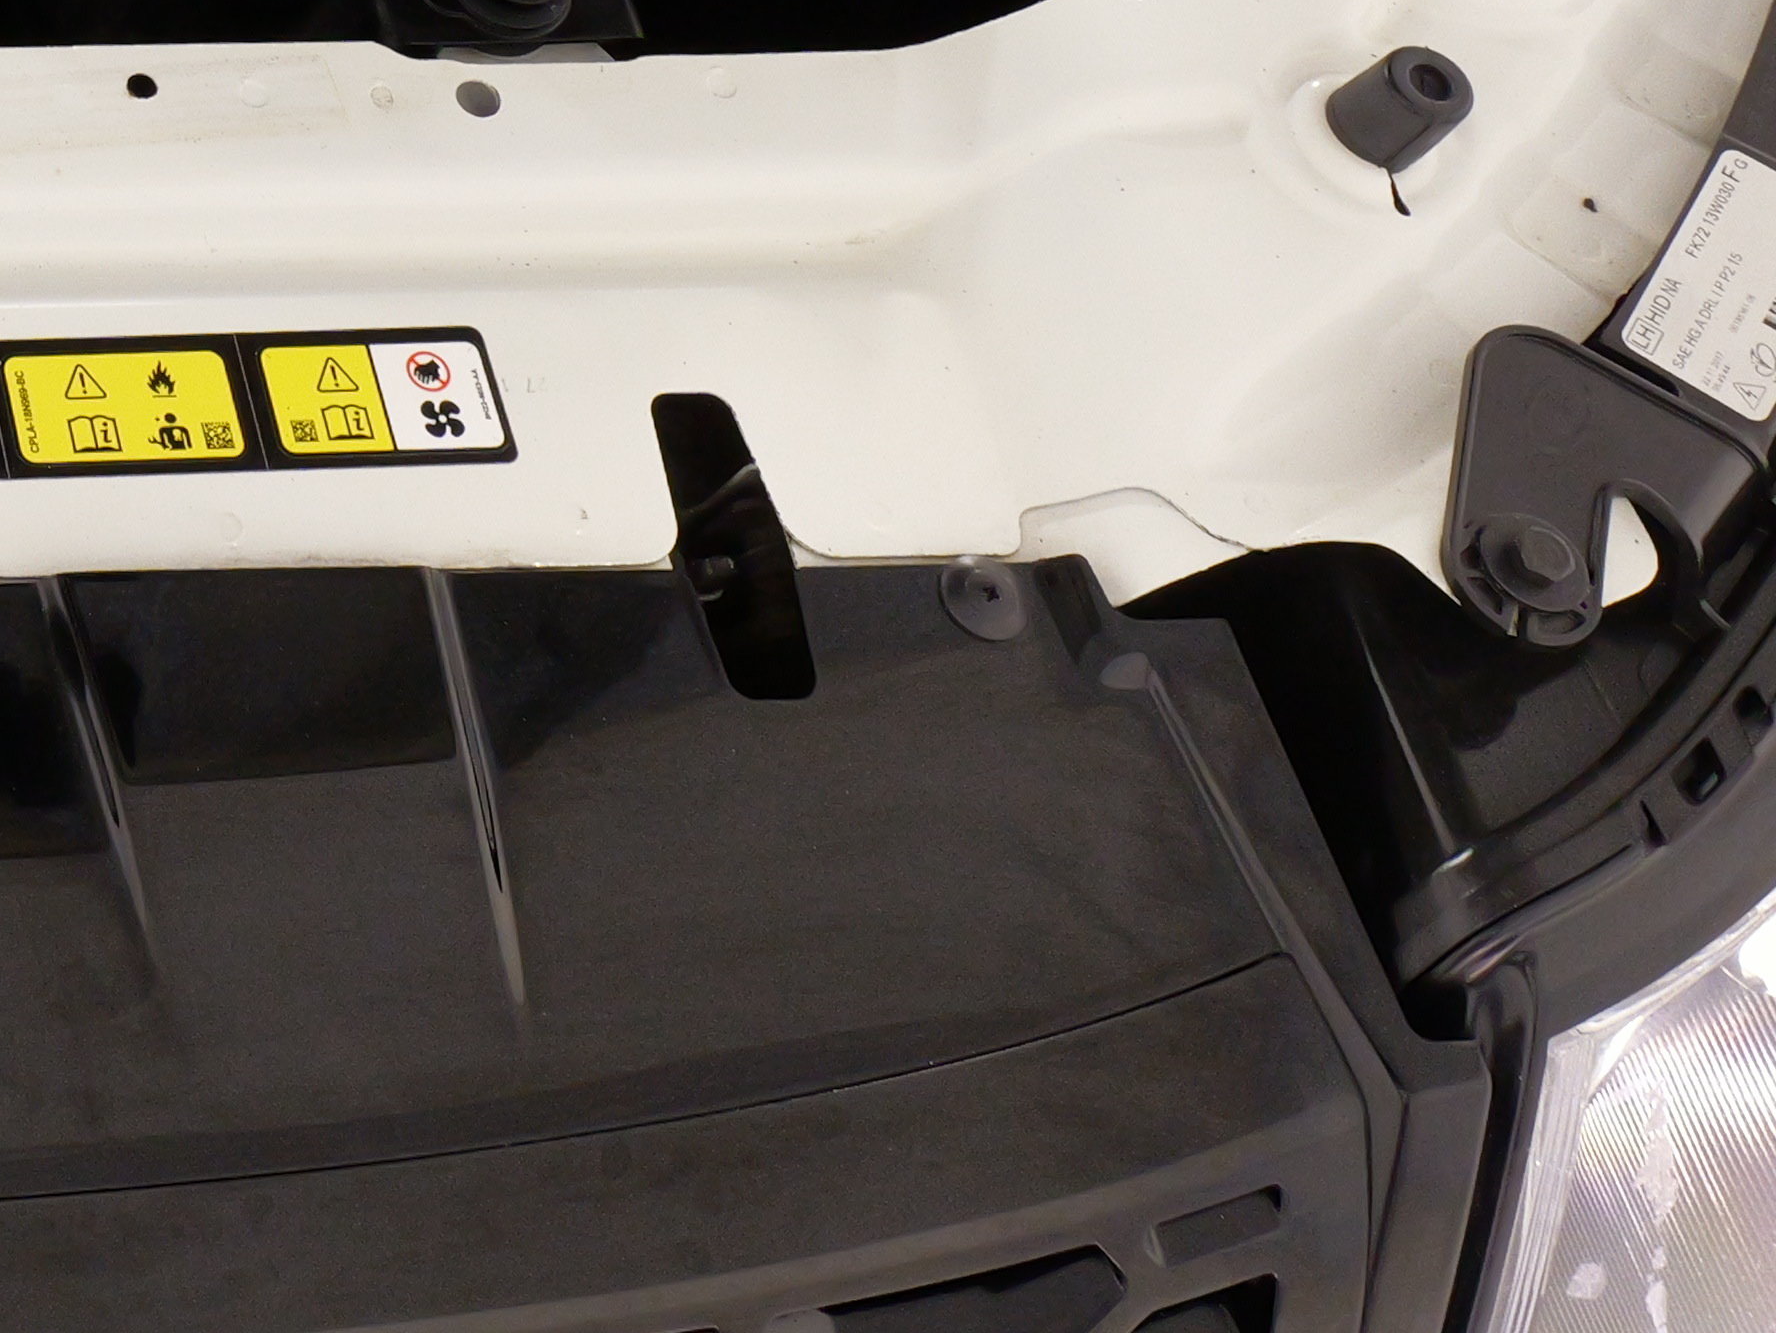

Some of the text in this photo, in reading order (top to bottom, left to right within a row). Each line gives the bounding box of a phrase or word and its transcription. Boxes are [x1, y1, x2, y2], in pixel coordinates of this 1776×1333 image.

[1646, 294, 1671, 324] HID
[1662, 278, 1681, 297] NA
[1673, 346, 1691, 370] SAE
